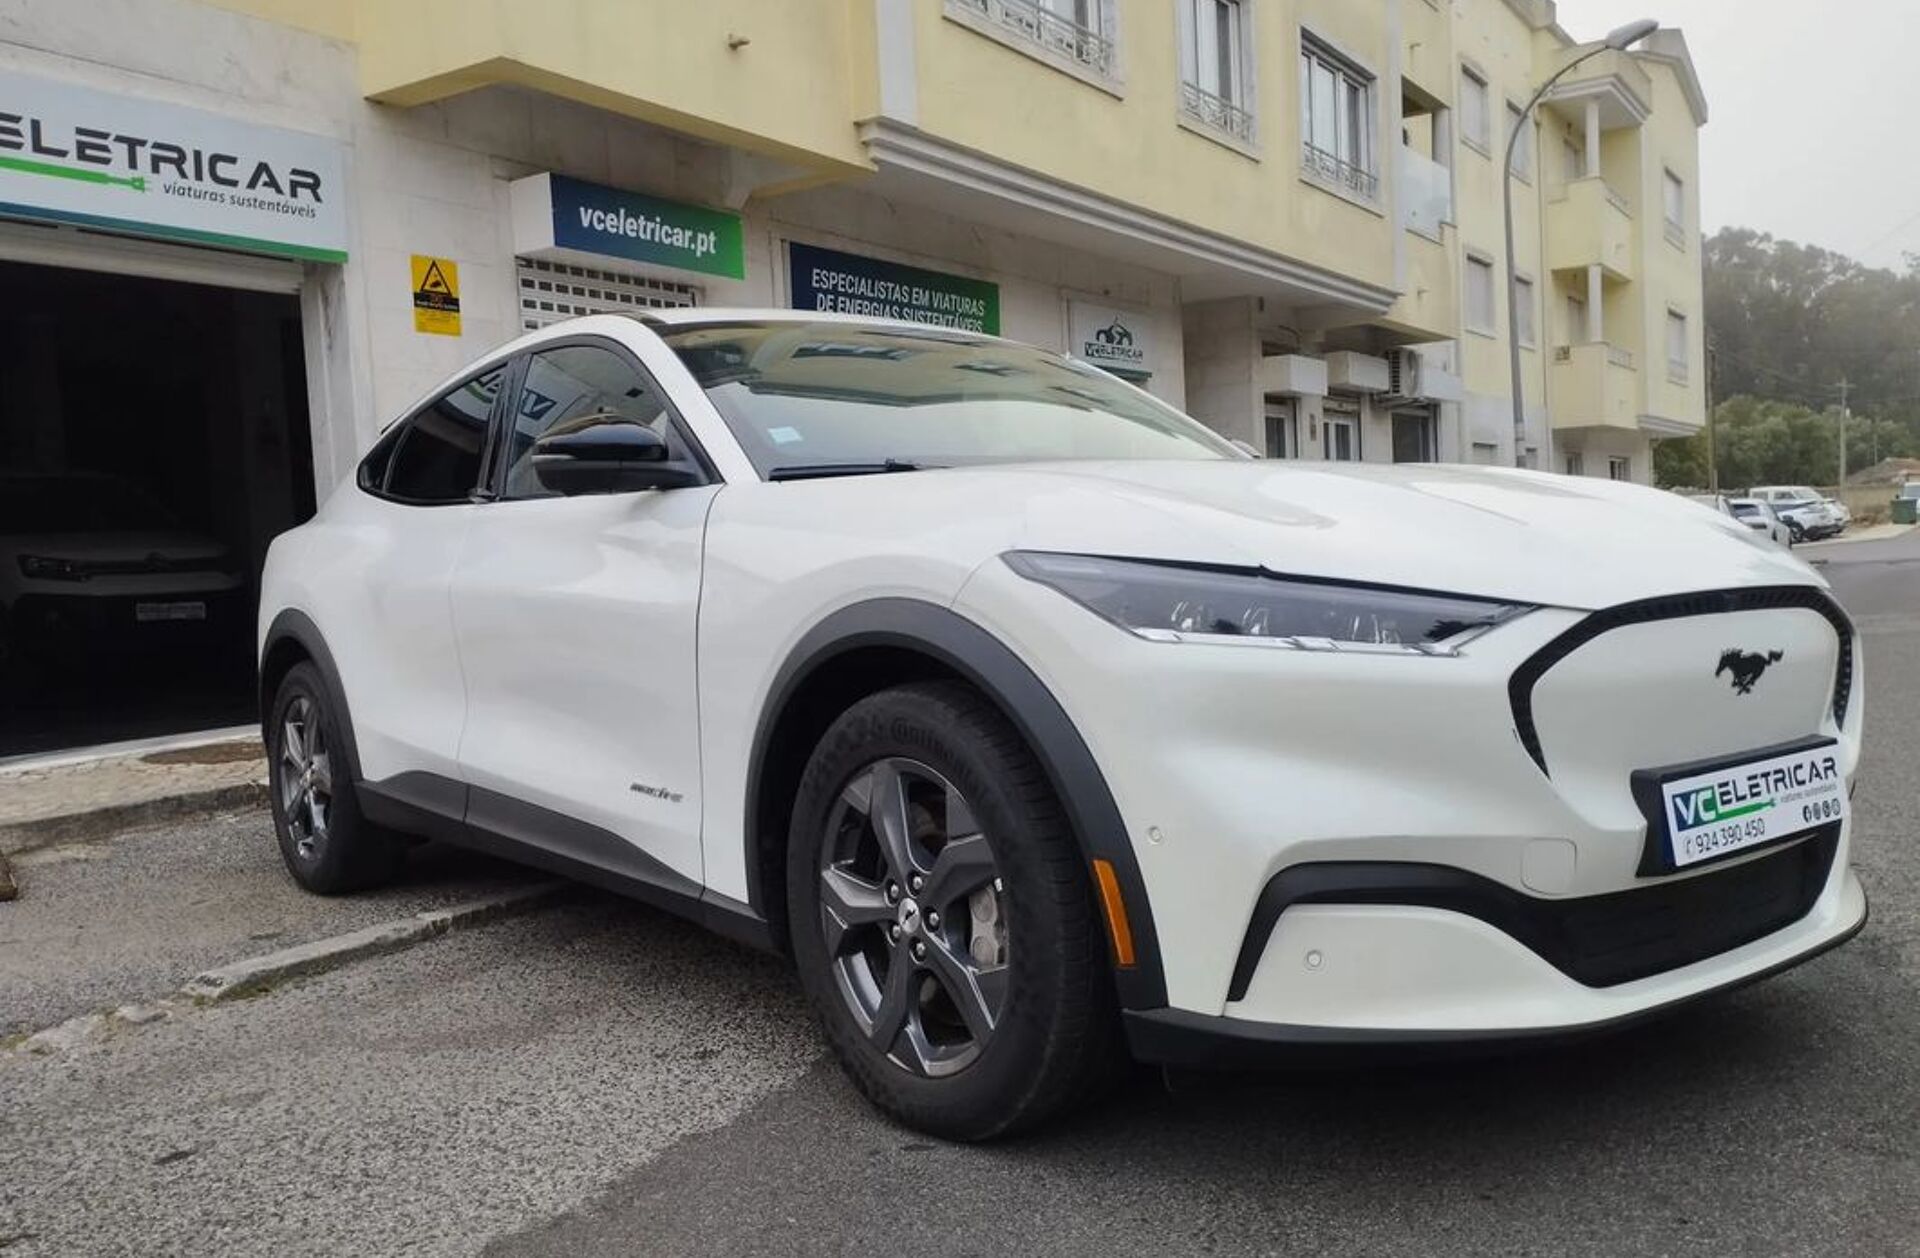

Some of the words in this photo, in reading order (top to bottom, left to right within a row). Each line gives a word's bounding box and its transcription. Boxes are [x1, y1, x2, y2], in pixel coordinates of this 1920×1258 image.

[0, 111, 323, 203] ELETRICAR
[163, 181, 226, 204] viaturas
[229, 193, 316, 219] sustentáveis
[579, 206, 716, 256] vceletricar.pt
[812, 268, 910, 303] ESPECIALISTAS
[912, 287, 929, 306] EM
[932, 292, 985, 317] VIATURAS
[816, 293, 835, 312] DE
[1674, 757, 1838, 826] VCELETRICAR
[1696, 834, 1719, 854] 924
[1721, 826, 1743, 847] 390
[1744, 818, 1765, 837] 450
